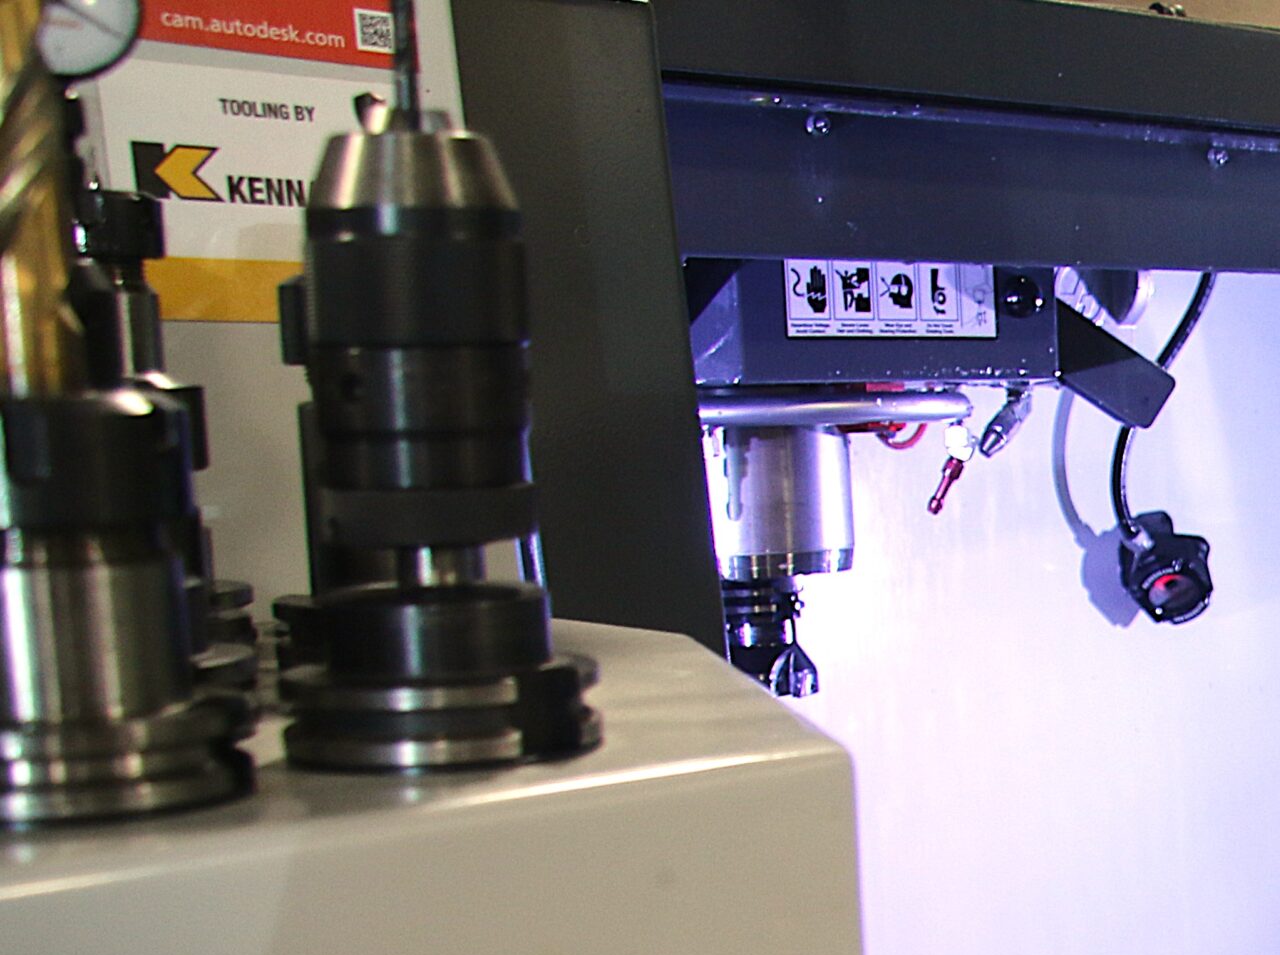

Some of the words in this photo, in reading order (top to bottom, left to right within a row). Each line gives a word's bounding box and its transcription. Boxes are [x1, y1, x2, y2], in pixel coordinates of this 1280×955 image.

[160, 9, 346, 49] cam.autodesk.com
[218, 98, 290, 121] TOOLING
[294, 104, 315, 123] BY
